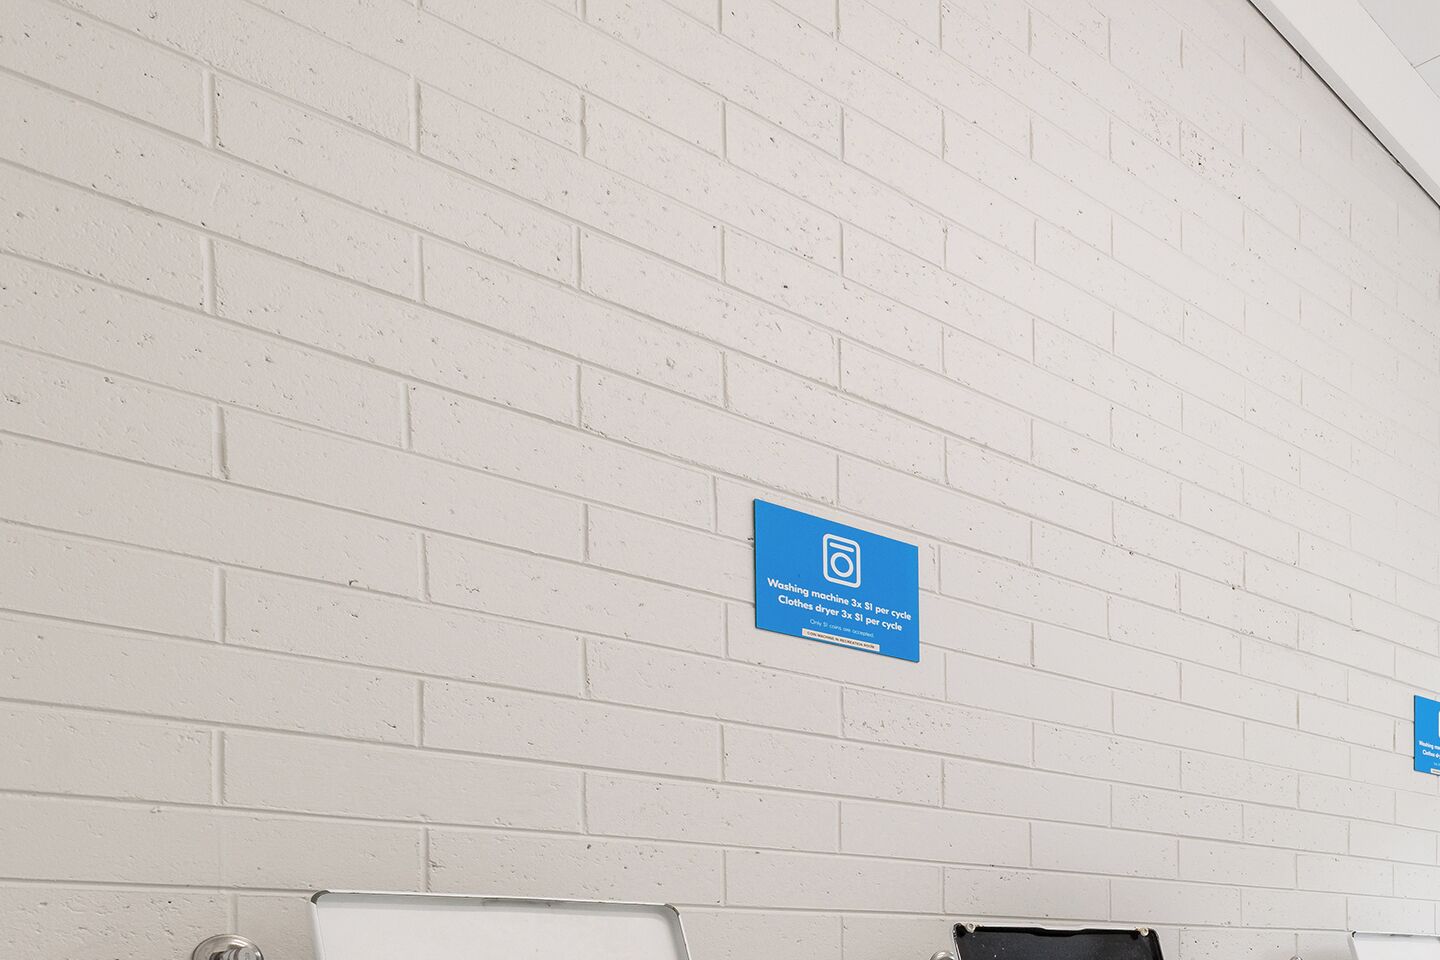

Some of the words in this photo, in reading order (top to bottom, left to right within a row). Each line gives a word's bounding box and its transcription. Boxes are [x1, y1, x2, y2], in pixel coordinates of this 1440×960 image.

[767, 577, 809, 597] Washing
[812, 591, 849, 605] machine
[851, 599, 862, 608] 3x
[875, 606, 889, 614] per
[891, 610, 911, 620] cycle
[778, 594, 813, 610] Clothes
[815, 604, 839, 616] dryer
[841, 610, 852, 619] 3x
[865, 617, 880, 625] per
[881, 621, 902, 631] cycle
